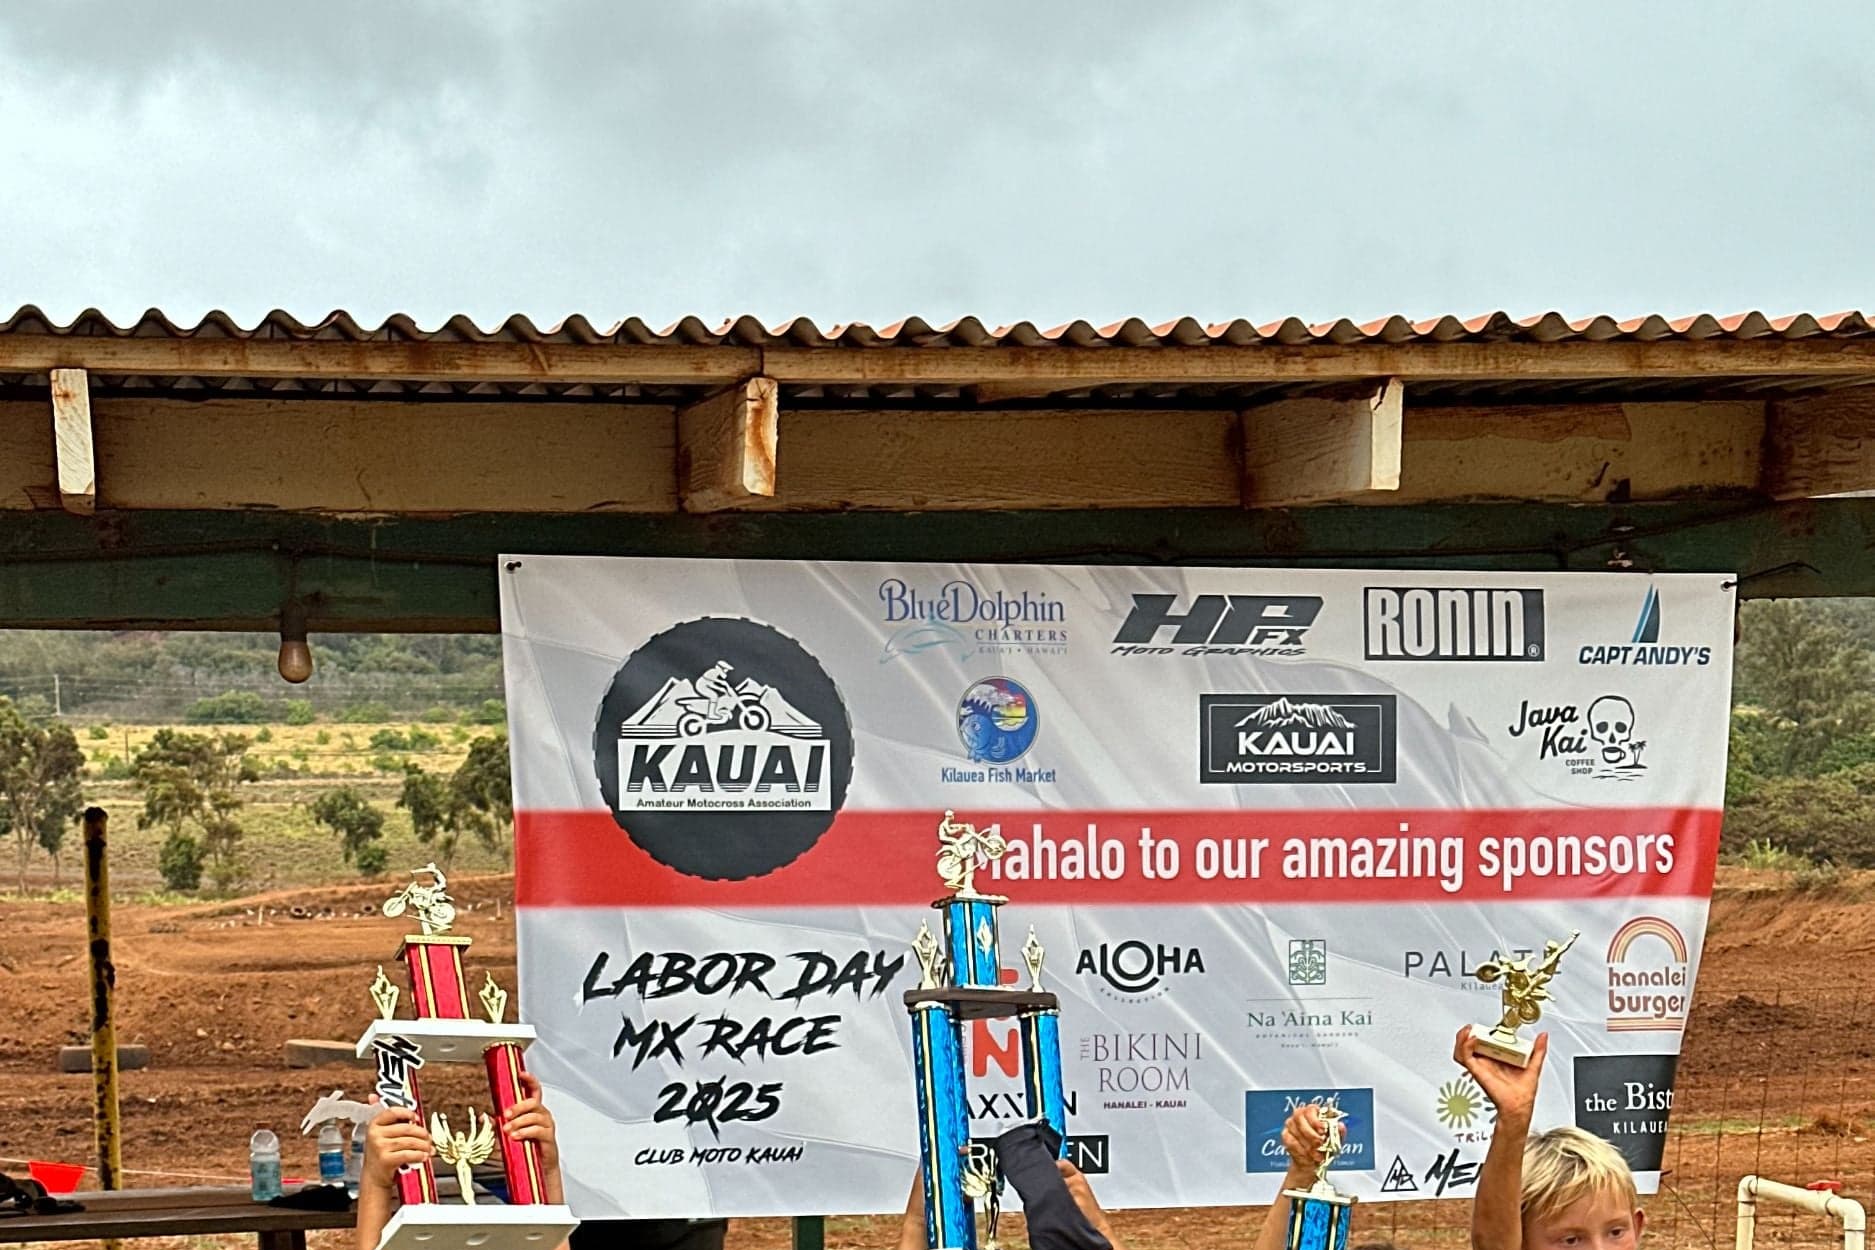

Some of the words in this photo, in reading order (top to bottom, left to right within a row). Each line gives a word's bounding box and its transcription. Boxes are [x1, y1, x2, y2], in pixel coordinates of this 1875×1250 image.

[975, 628, 1068, 641] CHARTERS
[1578, 645, 1633, 666] CAPT
[1633, 646, 1712, 666] ANDY'S
[1508, 700, 1579, 737] Java
[1238, 731, 1355, 756] KAUAI
[1540, 725, 1588, 761] Kai
[626, 744, 825, 793] KAUAI
[941, 767, 985, 783] Kilauea
[988, 767, 1013, 783] Fish
[1015, 767, 1057, 783] Market
[1225, 761, 1367, 774] MOTORSPORTS
[1565, 758, 1596, 767] COFFEE
[1571, 767, 1594, 775] SHOP
[636, 797, 684, 809] Amateur
[686, 797, 745, 809] Motocross
[747, 797, 812, 809] Association
[1137, 827, 1180, 880] to
[1195, 837, 1269, 880] our
[1281, 822, 1465, 893] amazing
[1477, 832, 1675, 892] sponsors
[1076, 940, 1206, 993] ALOHA
[1608, 966, 1686, 987] hanalei
[582, 950, 776, 1003] LABOR
[772, 949, 905, 1010] DAY
[1247, 1012, 1276, 1028] Na
[1340, 1009, 1373, 1026] Kai
[611, 1011, 699, 1071] MX
[697, 1008, 842, 1065] RACE
[1080, 1036, 1090, 1061] THE
[1093, 1032, 1203, 1062] BIKINI
[1099, 1066, 1191, 1093] ROOM
[1103, 1100, 1147, 1110] HANALEI
[1155, 1100, 1187, 1109] KAUAI
[1584, 1092, 1618, 1112] the
[1623, 1082, 1675, 1111] Bist
[634, 1147, 684, 1166] CLUB
[688, 1146, 741, 1166] MOTO
[744, 1145, 805, 1165] KAUAI
